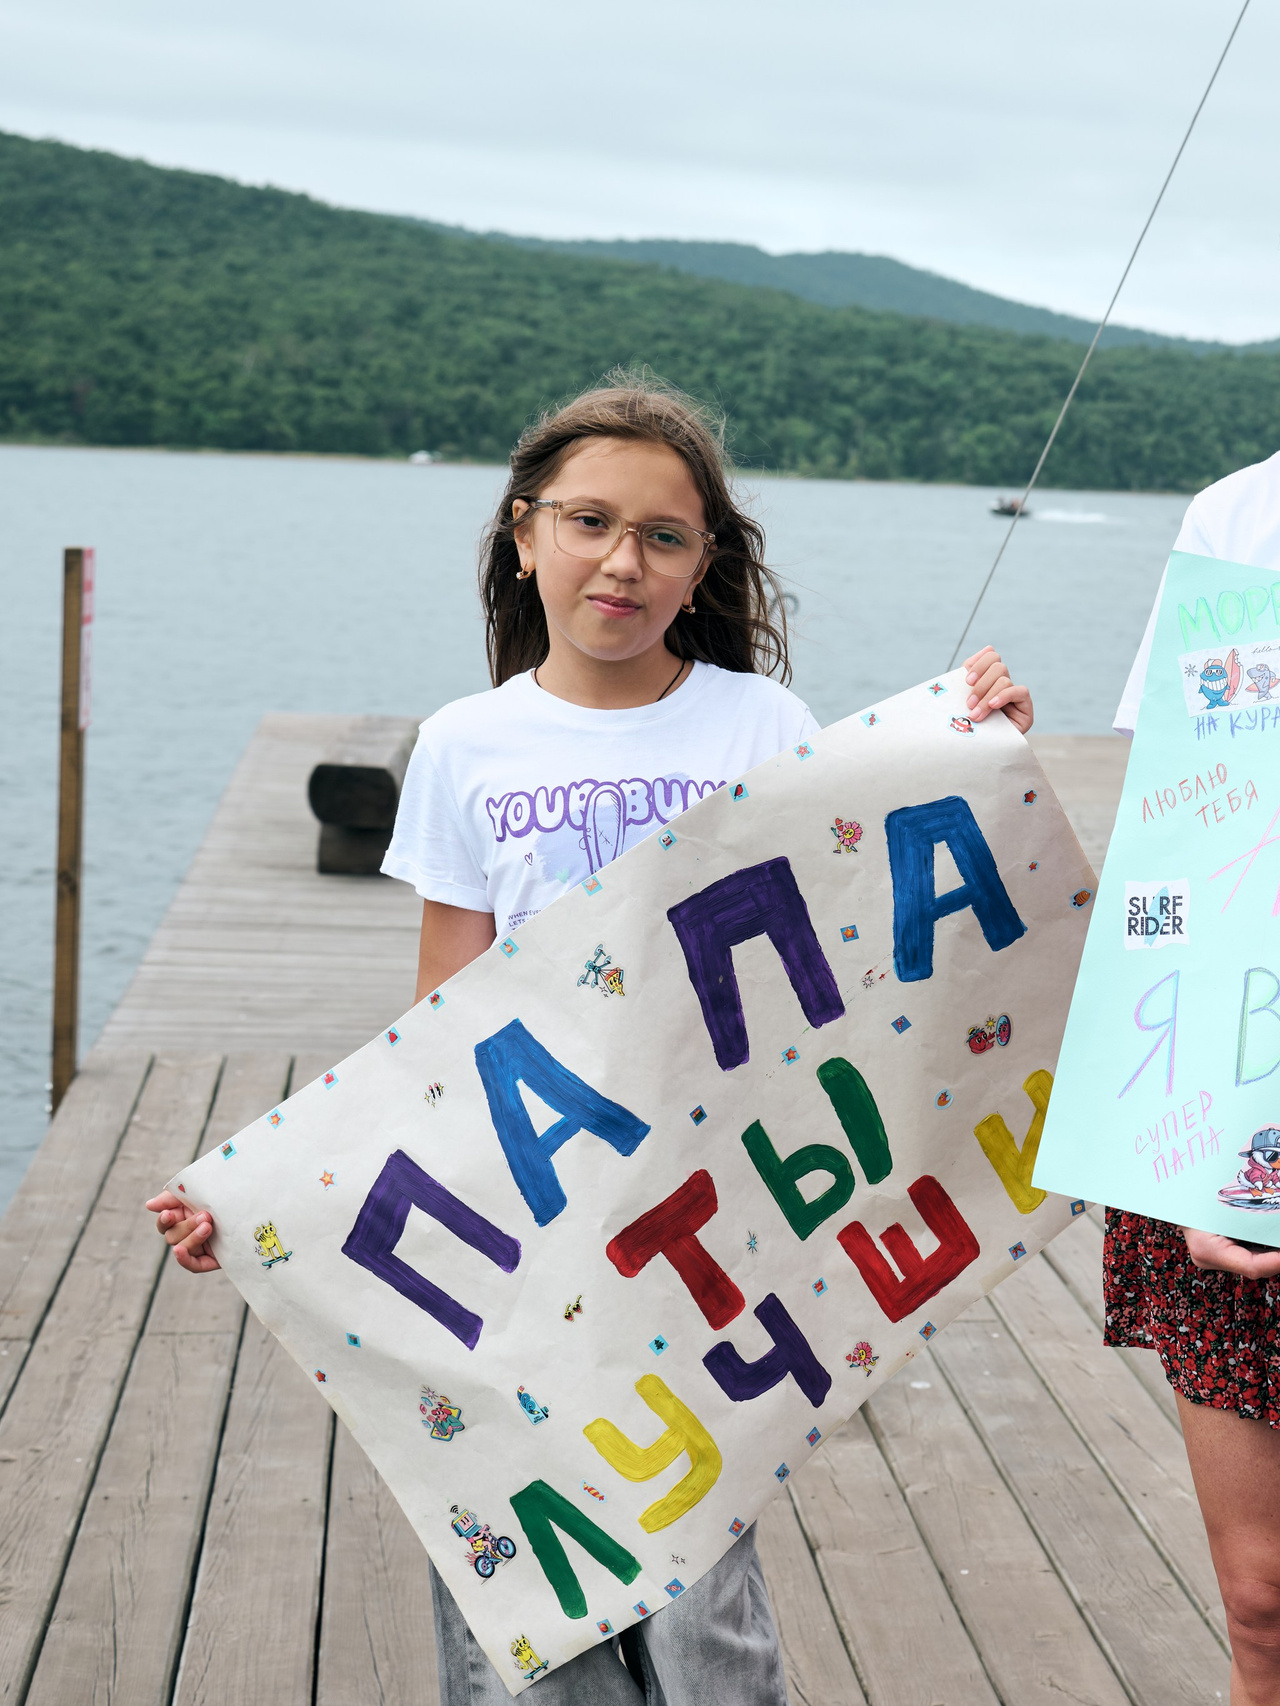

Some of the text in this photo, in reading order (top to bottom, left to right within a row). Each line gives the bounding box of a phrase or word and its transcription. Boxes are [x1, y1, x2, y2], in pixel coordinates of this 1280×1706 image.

[1195, 713, 1219, 741] НА
[1142, 762, 1228, 824] ЛЮБЛЮ
[1195, 779, 1260, 829] ТЕБЯ
[1127, 915, 1184, 936] RIDER
[1117, 969, 1180, 1100] Я
[341, 796, 1028, 1350] ПАПА
[1134, 1090, 1214, 1155] СУПЕР
[1153, 1127, 1225, 1183] ПАПА
[606, 1057, 893, 1330] ТЫ
[509, 1069, 1055, 1618] ЛУЧШИ
